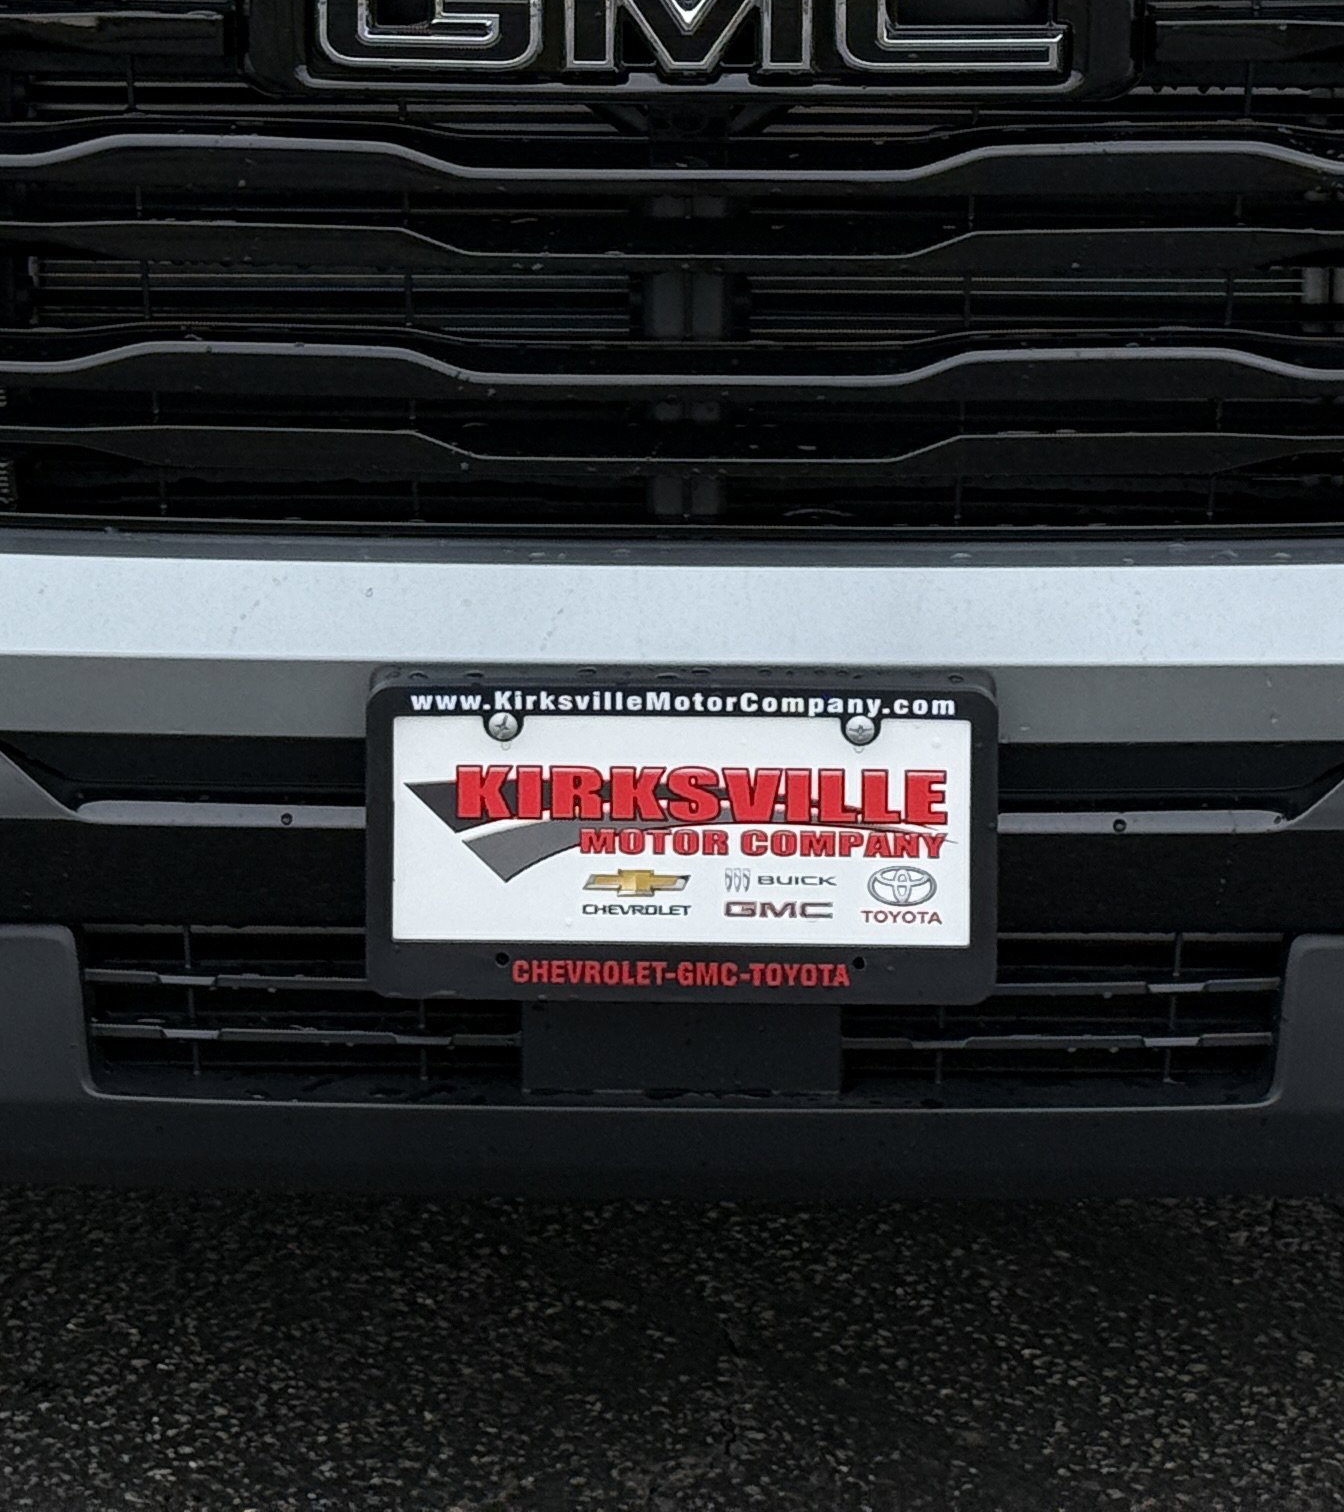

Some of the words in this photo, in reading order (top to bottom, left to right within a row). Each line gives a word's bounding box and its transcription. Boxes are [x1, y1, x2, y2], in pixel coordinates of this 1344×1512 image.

[410, 690, 956, 717] www.KirksvilleMotorCompany.com
[455, 764, 949, 825] KIRKSVILLE
[579, 828, 730, 856] MOTOR
[740, 830, 949, 859] COMPANY
[757, 875, 838, 887] BUICK
[581, 904, 693, 916] CHEVROLET
[723, 901, 834, 919] GMC
[860, 910, 944, 925] TOYOTA
[511, 960, 851, 988] CHEVROLET-GMC-TOYOTA
